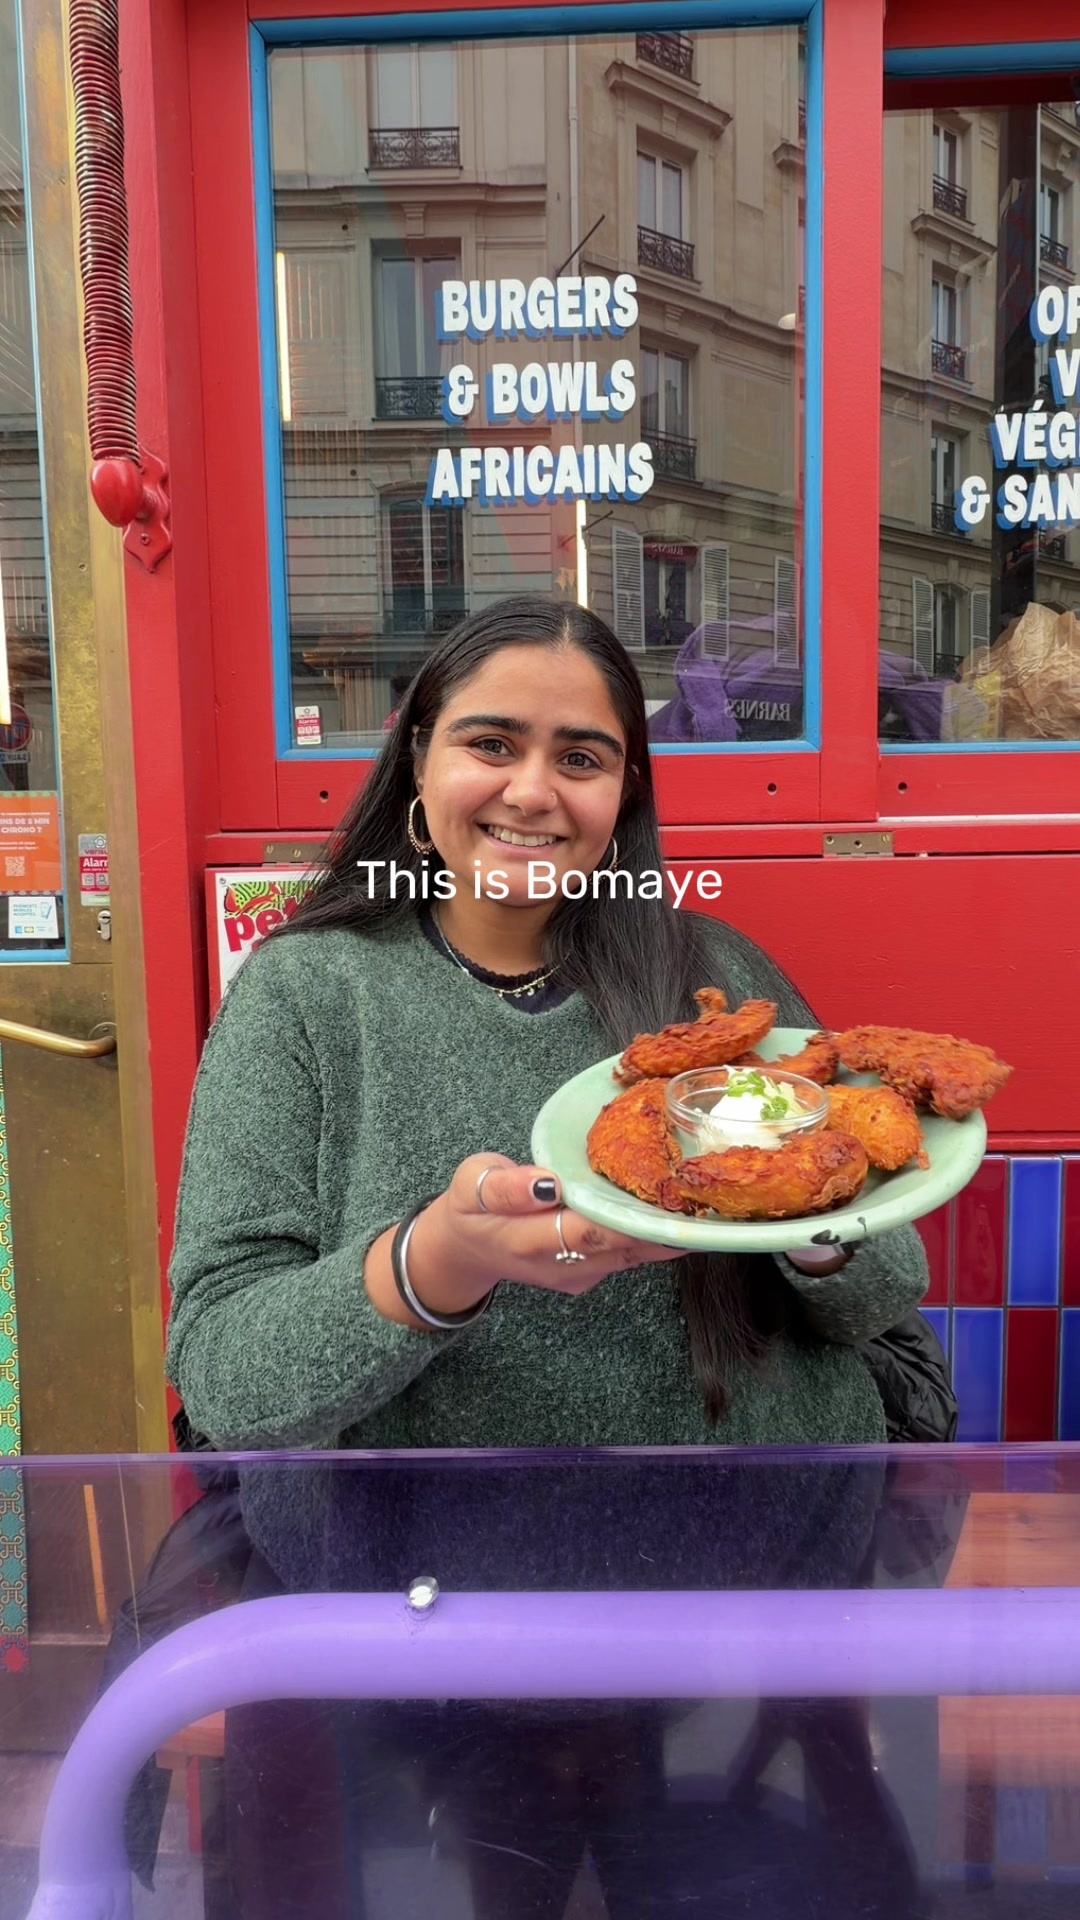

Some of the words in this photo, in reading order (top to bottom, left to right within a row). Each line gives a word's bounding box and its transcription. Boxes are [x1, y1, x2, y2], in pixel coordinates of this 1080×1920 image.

[440, 274, 639, 333] BURGERS
[1036, 285, 1080, 335] OP
[447, 364, 479, 416] &
[491, 359, 636, 414] BOWLS
[994, 399, 1080, 462] VÉG
[430, 442, 655, 499] AFRICAINS
[961, 475, 990, 524] &
[1003, 472, 1080, 523] SAN
